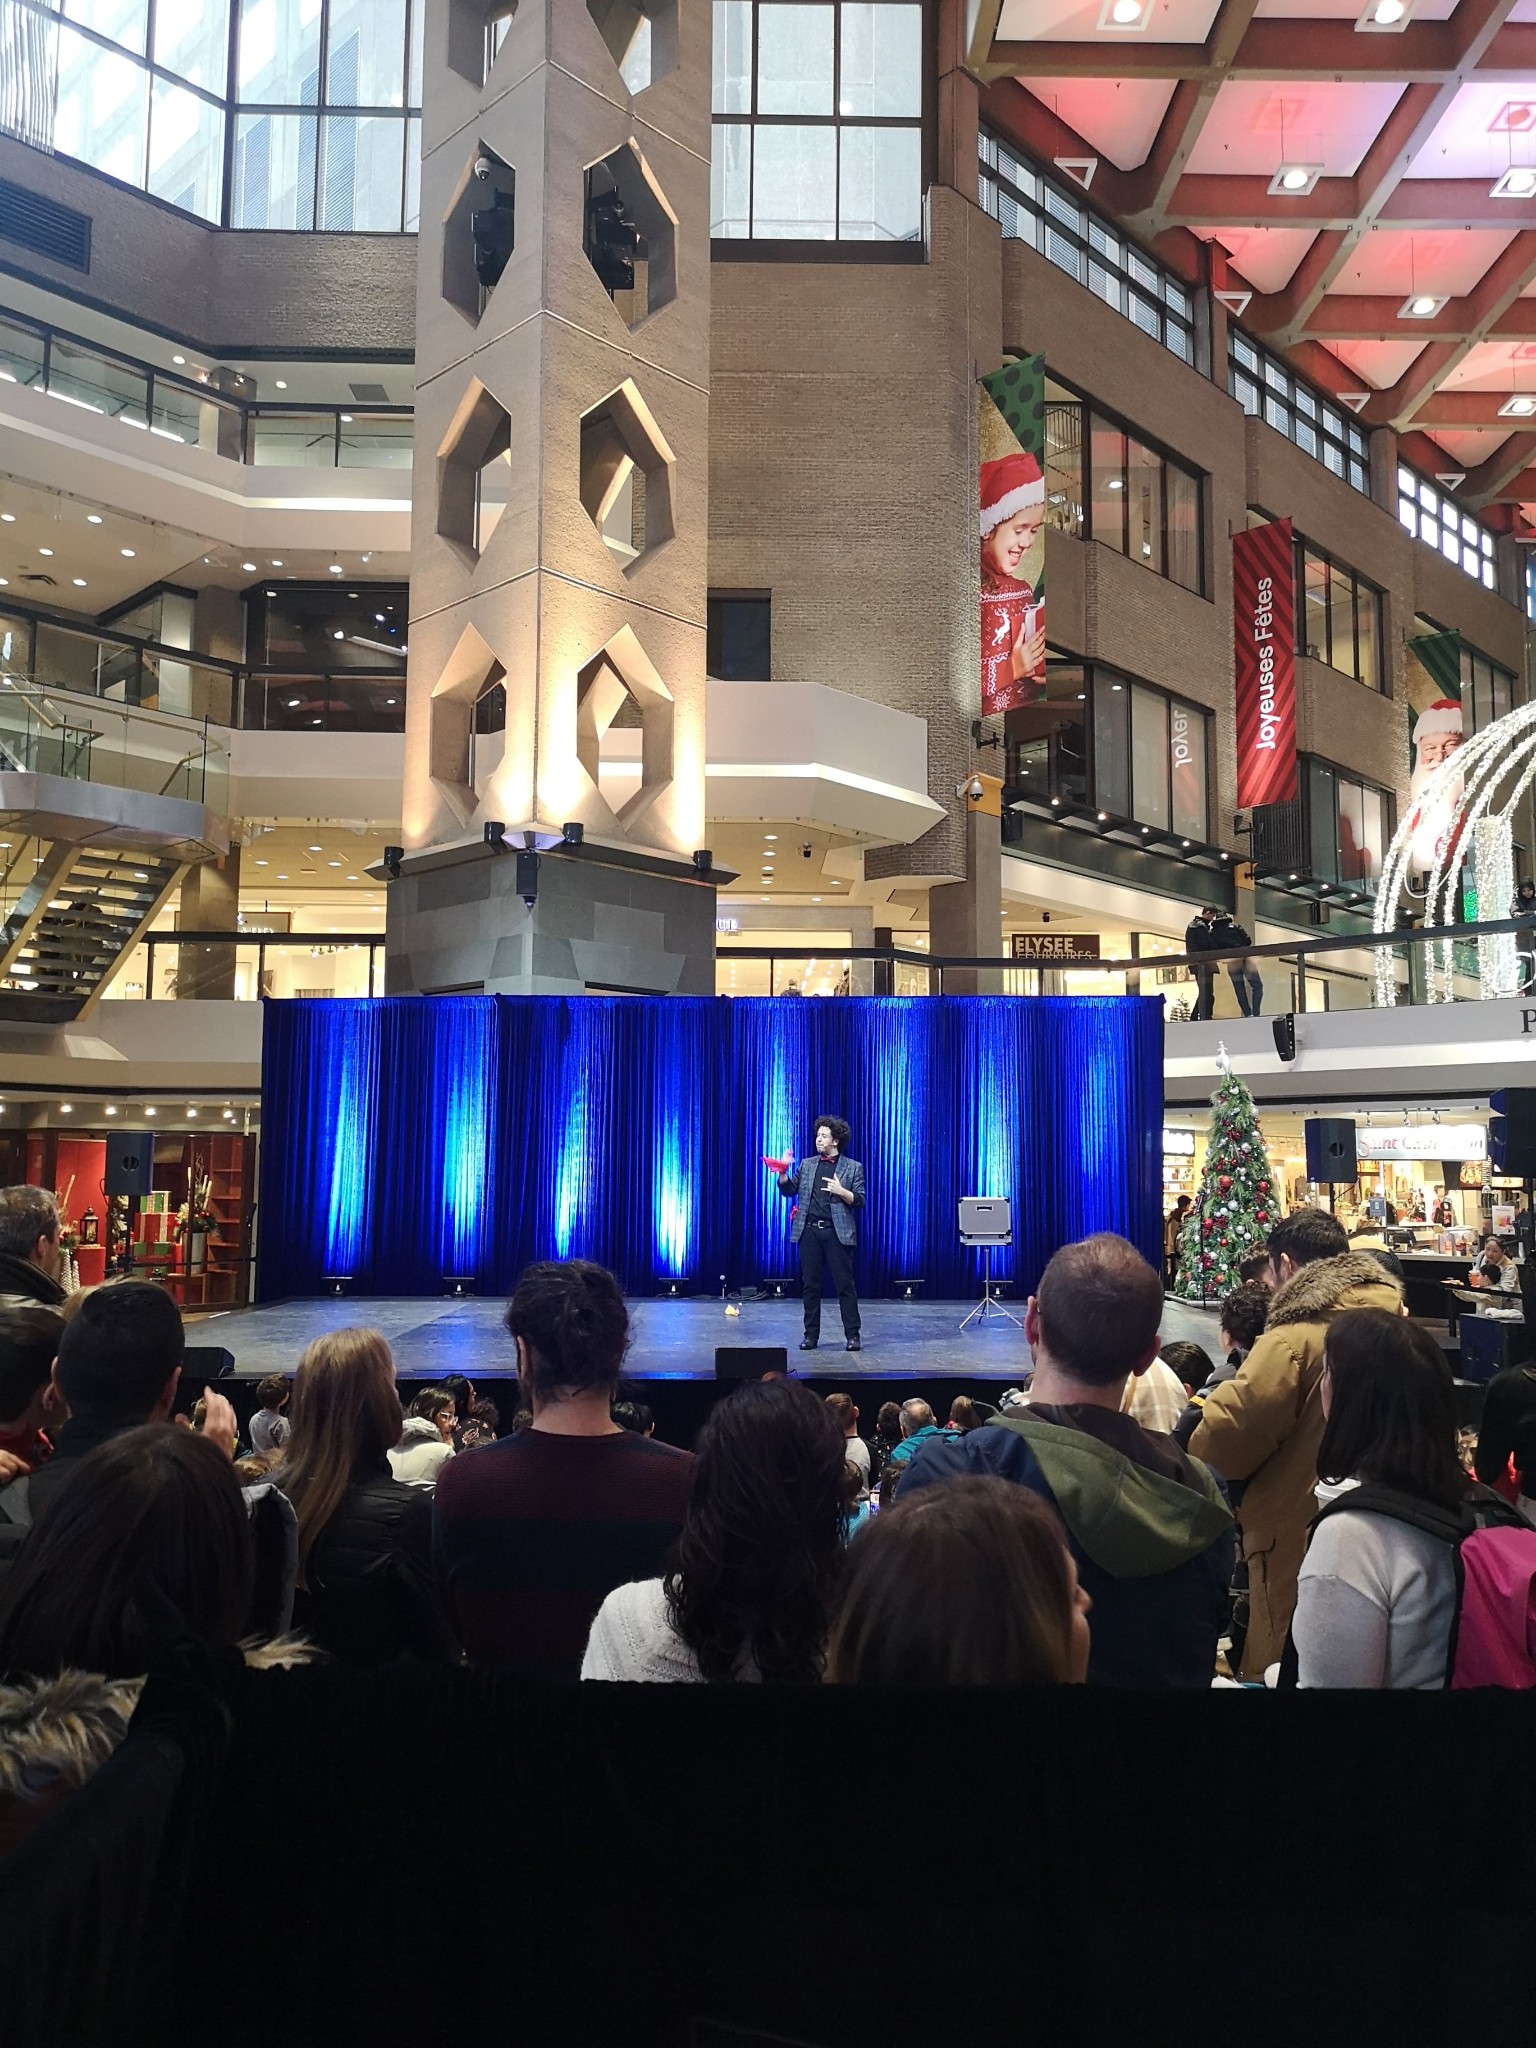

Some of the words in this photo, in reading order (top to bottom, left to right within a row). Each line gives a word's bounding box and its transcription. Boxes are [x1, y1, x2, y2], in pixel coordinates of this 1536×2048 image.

[1254, 577, 1273, 642] Fêtes
[1256, 645, 1281, 749] Joyeuses
[1015, 937, 1073, 953] ELYSEE
